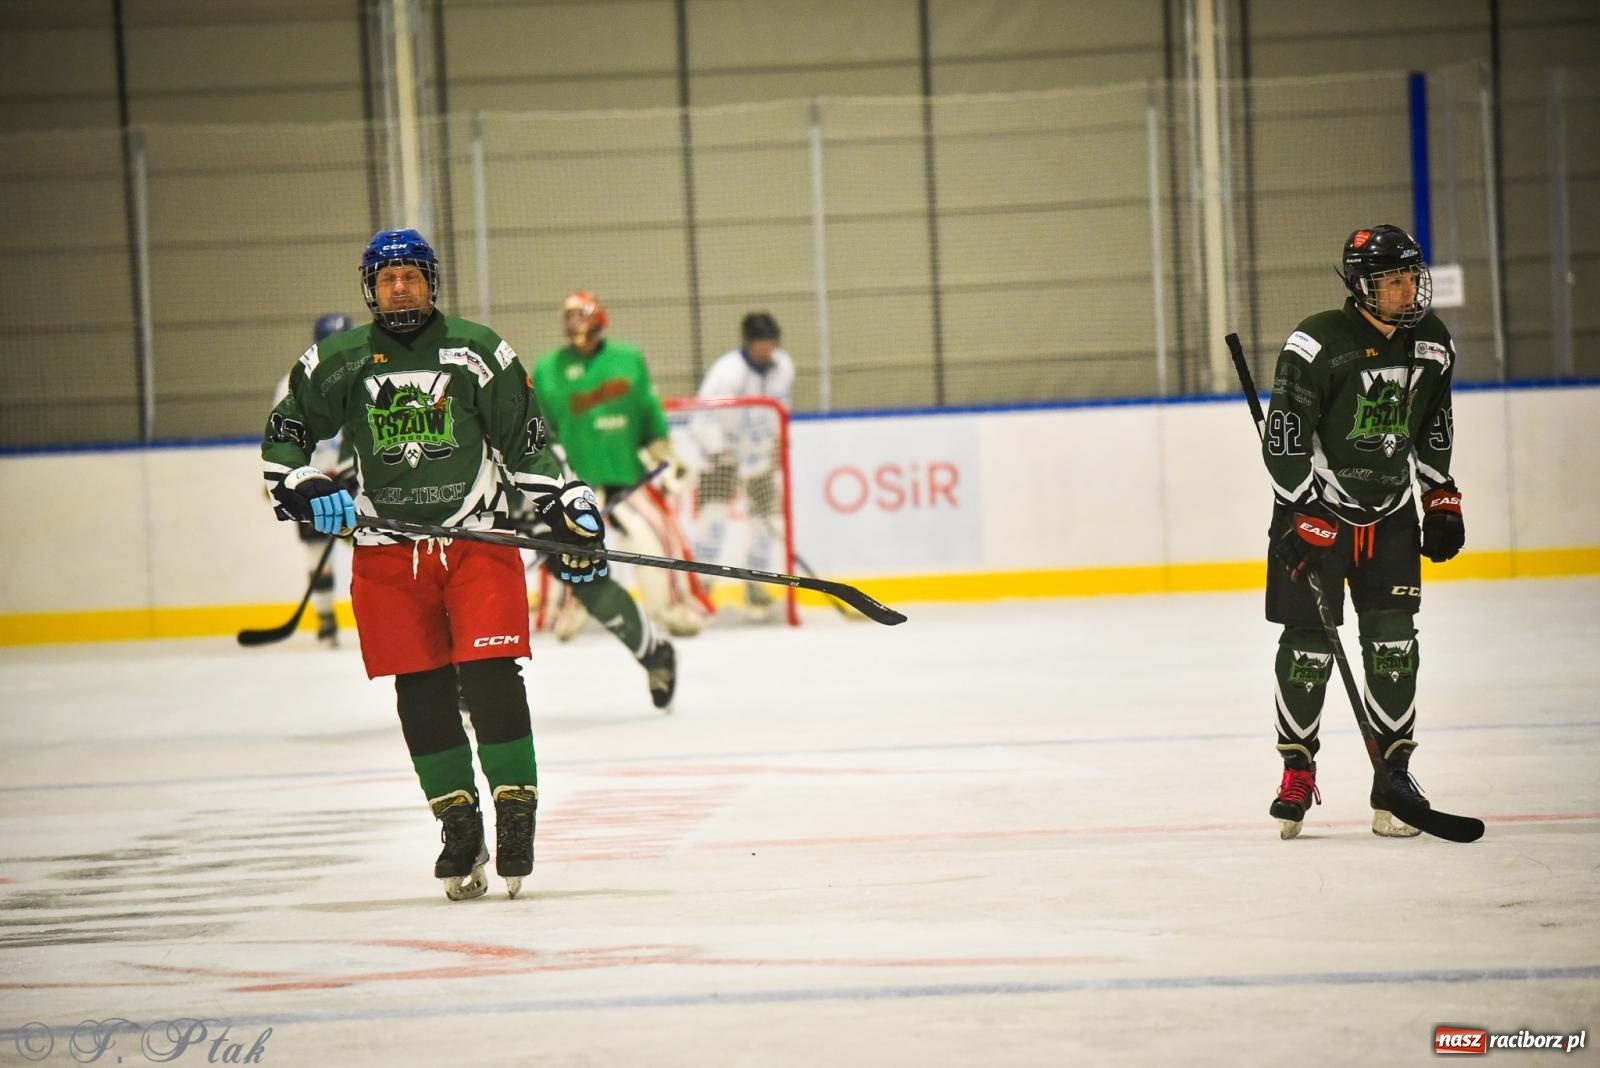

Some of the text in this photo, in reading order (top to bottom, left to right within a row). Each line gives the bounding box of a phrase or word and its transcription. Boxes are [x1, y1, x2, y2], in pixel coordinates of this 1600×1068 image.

[1268, 410, 1307, 456] 92
[1429, 407, 1453, 451] 9
[823, 460, 960, 516] OSiR
[1391, 585, 1421, 598] CC
[473, 634, 520, 648] CCM
